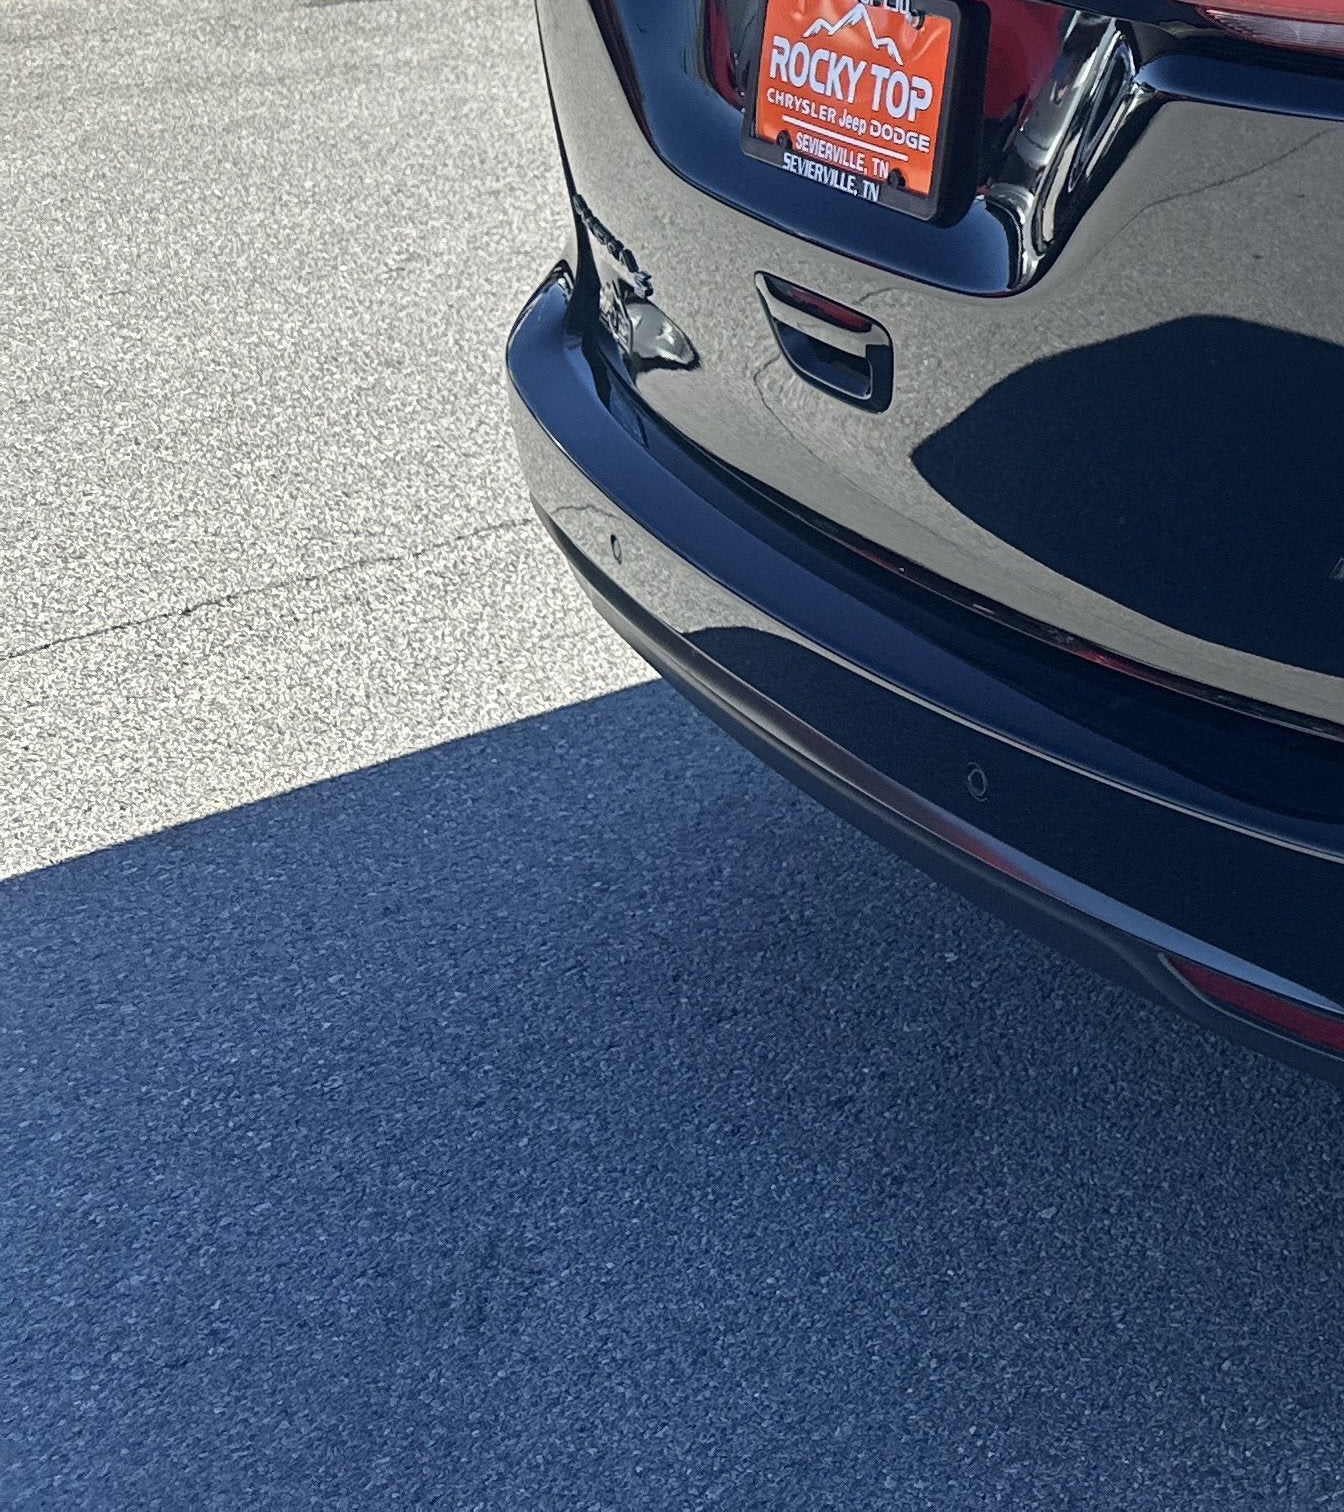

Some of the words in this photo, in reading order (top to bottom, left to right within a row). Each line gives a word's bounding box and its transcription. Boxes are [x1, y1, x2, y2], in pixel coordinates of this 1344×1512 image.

[769, 35, 865, 103] ROCKY
[871, 64, 933, 122] TOP
[767, 87, 836, 124] CHRYSLER
[838, 108, 867, 136] Jeep
[869, 119, 931, 154] DODGE
[783, 152, 858, 195] SEVIERVILLE,
[861, 180, 881, 202] TN
[795, 131, 868, 175] SEVIERVILLE,
[872, 159, 889, 180] TN
